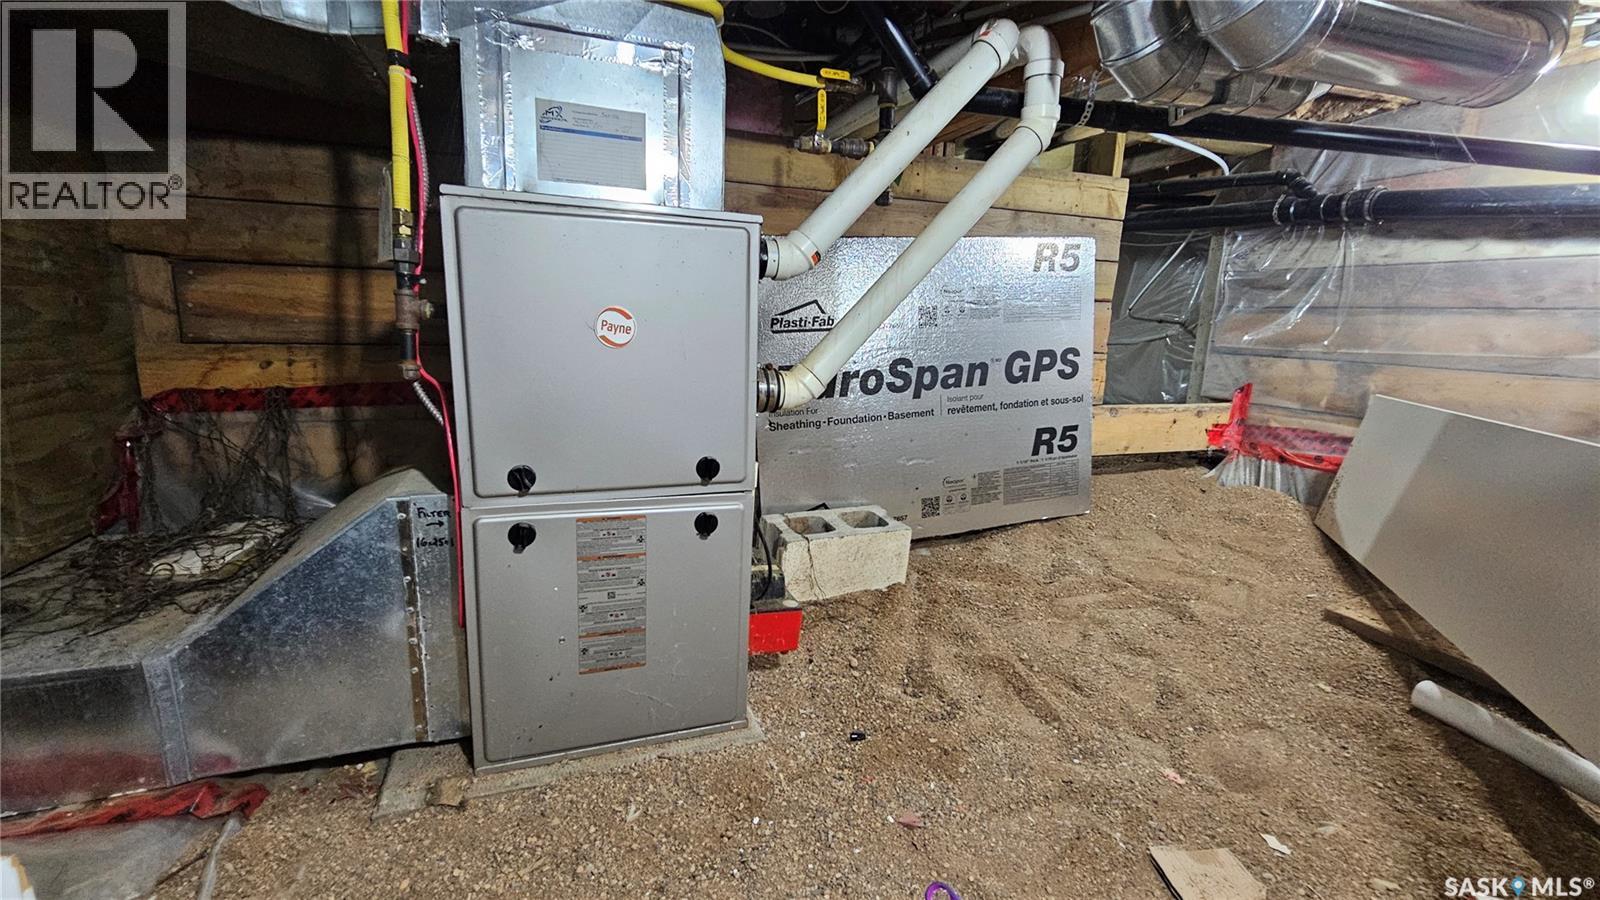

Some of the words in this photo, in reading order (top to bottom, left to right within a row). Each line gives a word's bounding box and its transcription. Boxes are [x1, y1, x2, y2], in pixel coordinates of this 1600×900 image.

[1033, 243, 1081, 273] R5
[600, 319, 632, 336] Payne
[778, 357, 989, 399] roSpan
[1004, 347, 1080, 384] GPS
[947, 394, 968, 403] Isolant
[969, 394, 984, 403] pour
[1000, 400, 1039, 411] fondation
[1040, 398, 1049, 407] et
[1050, 394, 1084, 406] sous-sol
[806, 406, 819, 415] For
[1031, 424, 1079, 457] R5
